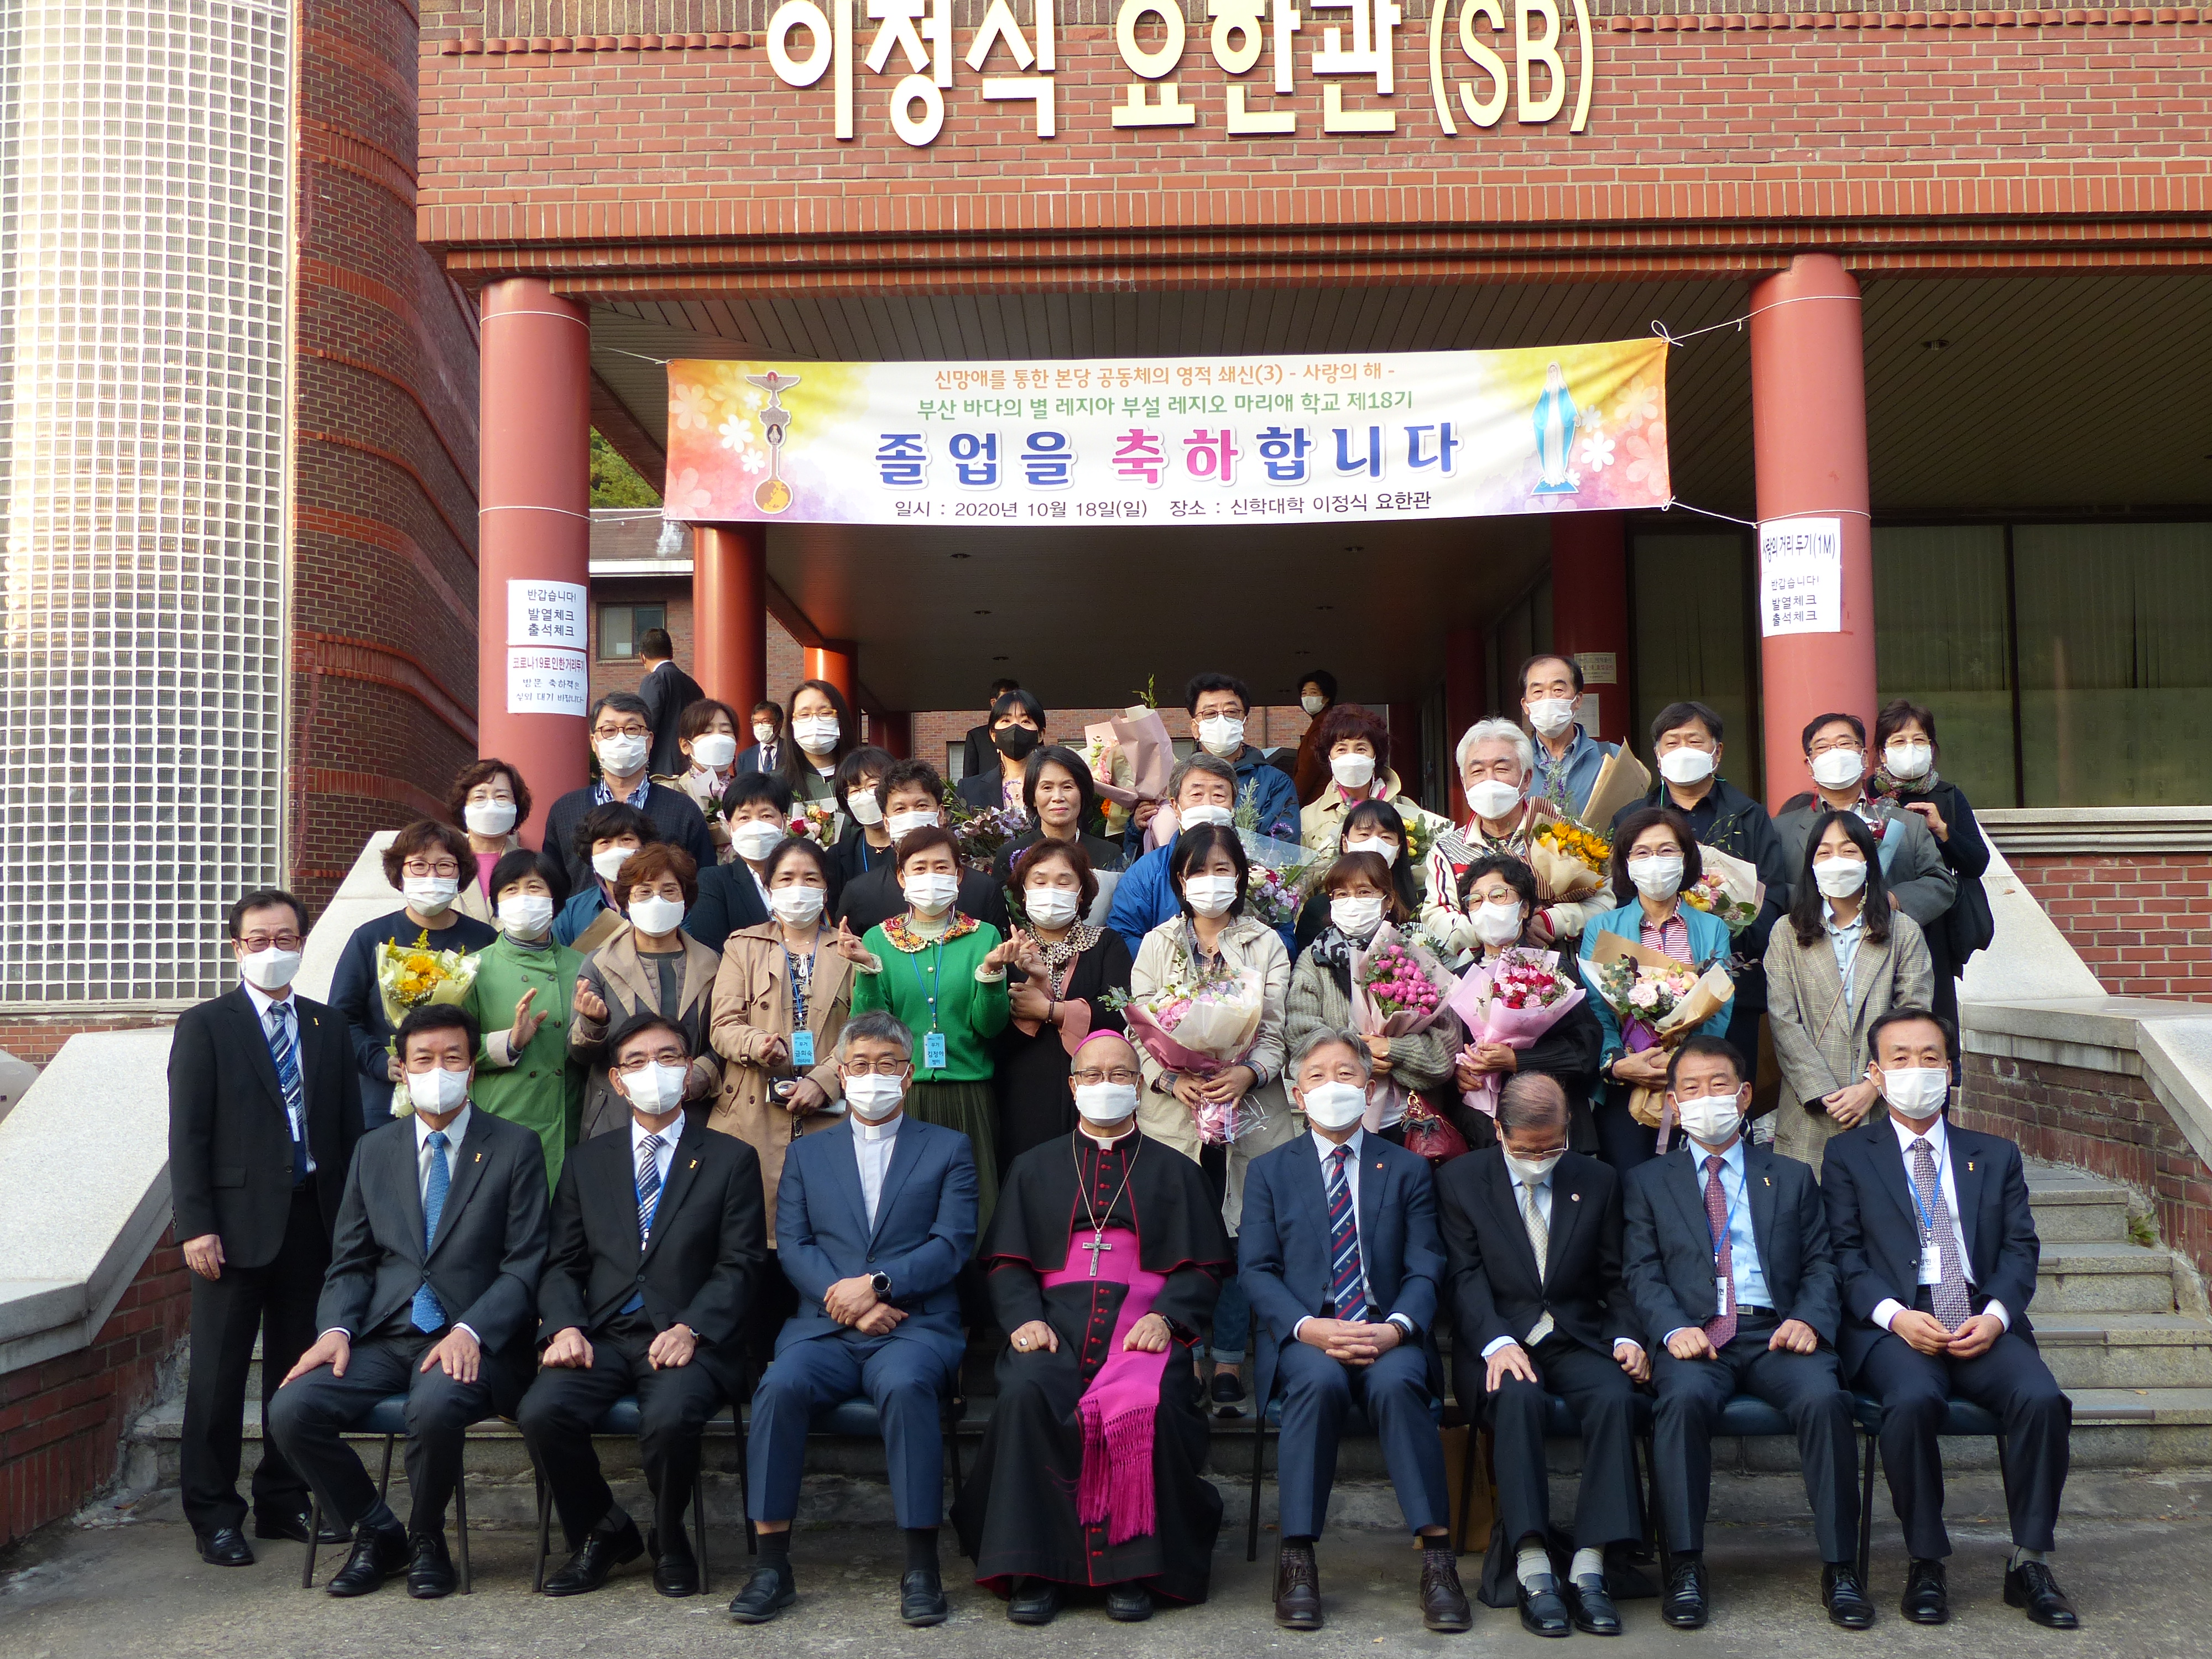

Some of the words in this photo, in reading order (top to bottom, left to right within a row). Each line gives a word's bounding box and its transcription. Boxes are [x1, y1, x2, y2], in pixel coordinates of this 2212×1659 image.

[766, 0, 1056, 147] 이정식
[935, 369, 1006, 390] 신망애를
[1013, 369, 1049, 389] 통한
[1055, 368, 1091, 388] 본당
[1097, 367, 1170, 387] 공동체의
[1177, 366, 1212, 387] 영적
[1218, 364, 1283, 385] 쇄신(3)
[1303, 363, 1357, 384] 사랑의
[1363, 362, 1381, 379] 해
[917, 399, 957, 421] 부산
[964, 398, 1021, 419] 바다의
[1030, 398, 1048, 419] 별
[1056, 397, 1115, 417] 레지아
[1121, 396, 1161, 419] 부설
[1168, 394, 1228, 415] 레지오
[1234, 394, 1293, 414] 마리애
[1301, 392, 1340, 415] 학교
[1347, 391, 1412, 411] 제18기
[895, 500, 931, 518] 일시
[955, 502, 1018, 518] 2020년
[1027, 501, 1066, 518] 10월
[1076, 500, 1147, 518] 18일(일)
[1170, 500, 1207, 517] 장소
[1230, 497, 1305, 515] 신학대학
[1313, 493, 1368, 513] 이정식
[1375, 491, 1432, 511] 요한관
[1771, 576, 1819, 591] 반갑습니다!
[528, 589, 577, 603] 반갑습니다!
[528, 608, 575, 621] 발열체크
[528, 623, 575, 637] 출석체크
[537, 693, 554, 702] 대기
